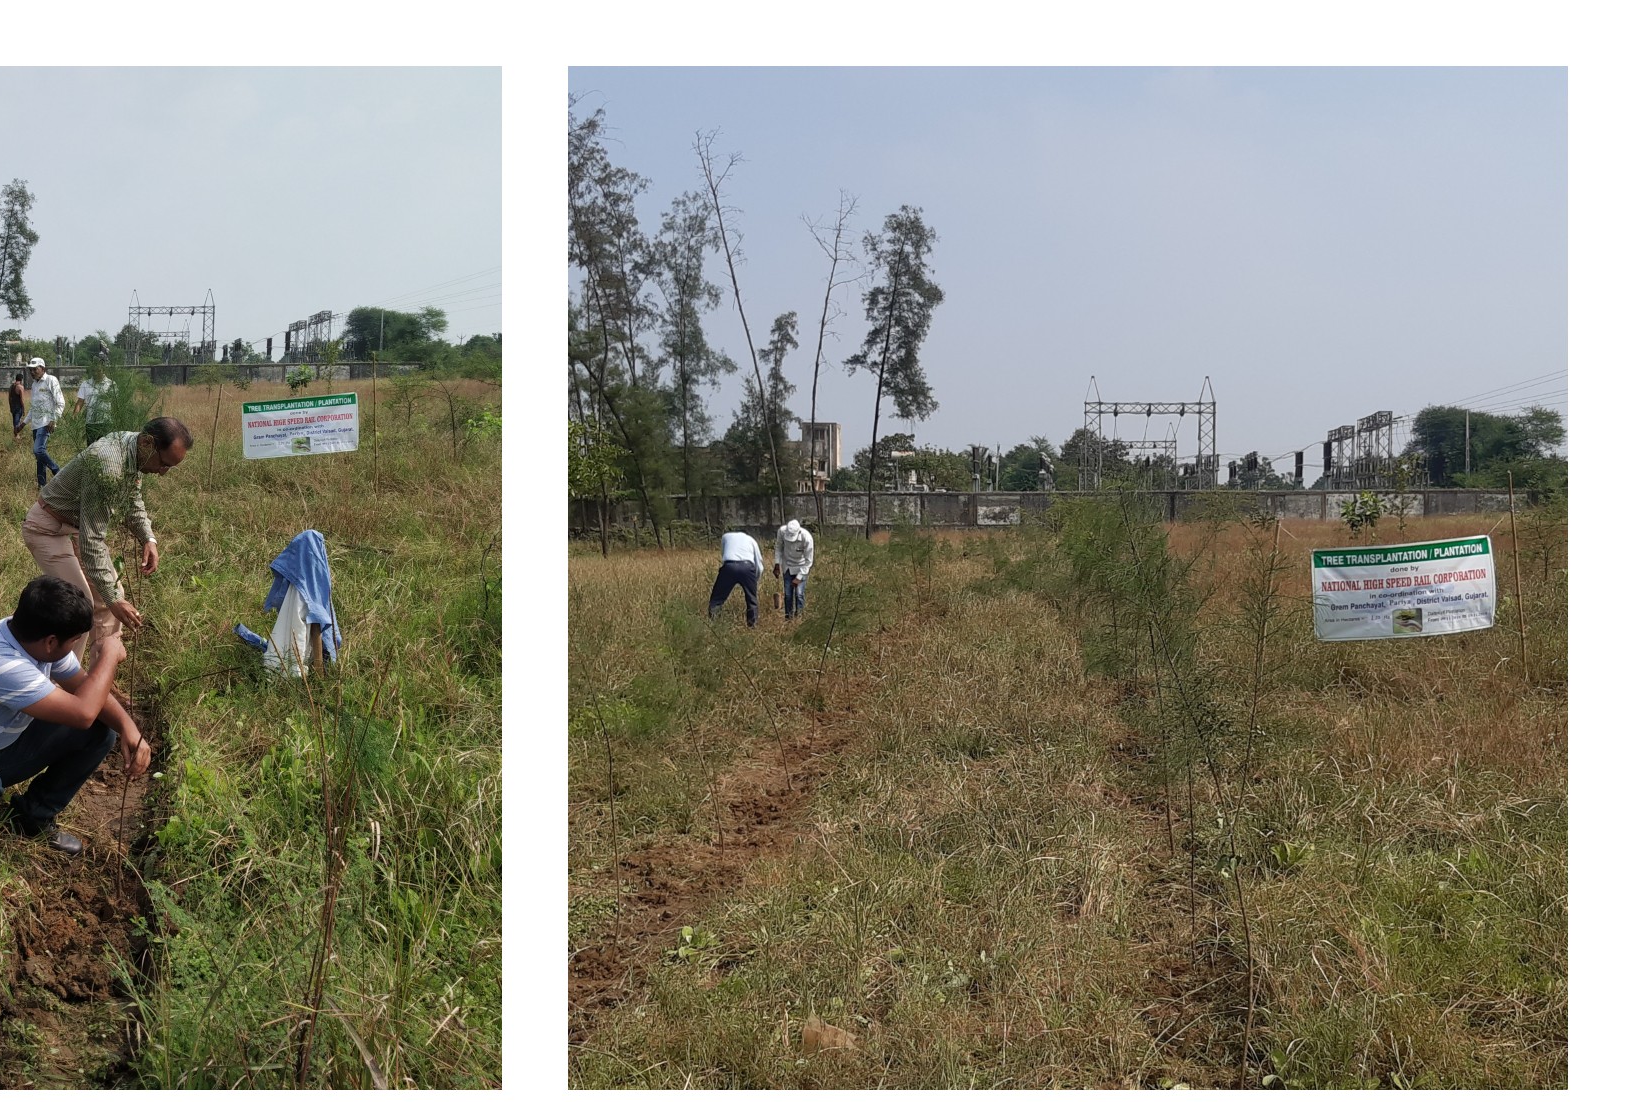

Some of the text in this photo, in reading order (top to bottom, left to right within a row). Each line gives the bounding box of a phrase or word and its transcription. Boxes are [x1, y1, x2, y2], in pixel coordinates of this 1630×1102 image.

[318, 397, 352, 406] PLANTATION
[248, 420, 272, 428] NATIONAL
[287, 417, 303, 425] SPEED
[1321, 556, 1344, 566] TREE
[1346, 550, 1427, 565] TRANSPLANTATION
[1434, 544, 1483, 558] PLANTATION
[1321, 569, 1486, 592] NATIONAL HIGH SPEED RAIL CORPORATION
[1379, 590, 1427, 599] co-ordination
[1417, 597, 1440, 605] District
